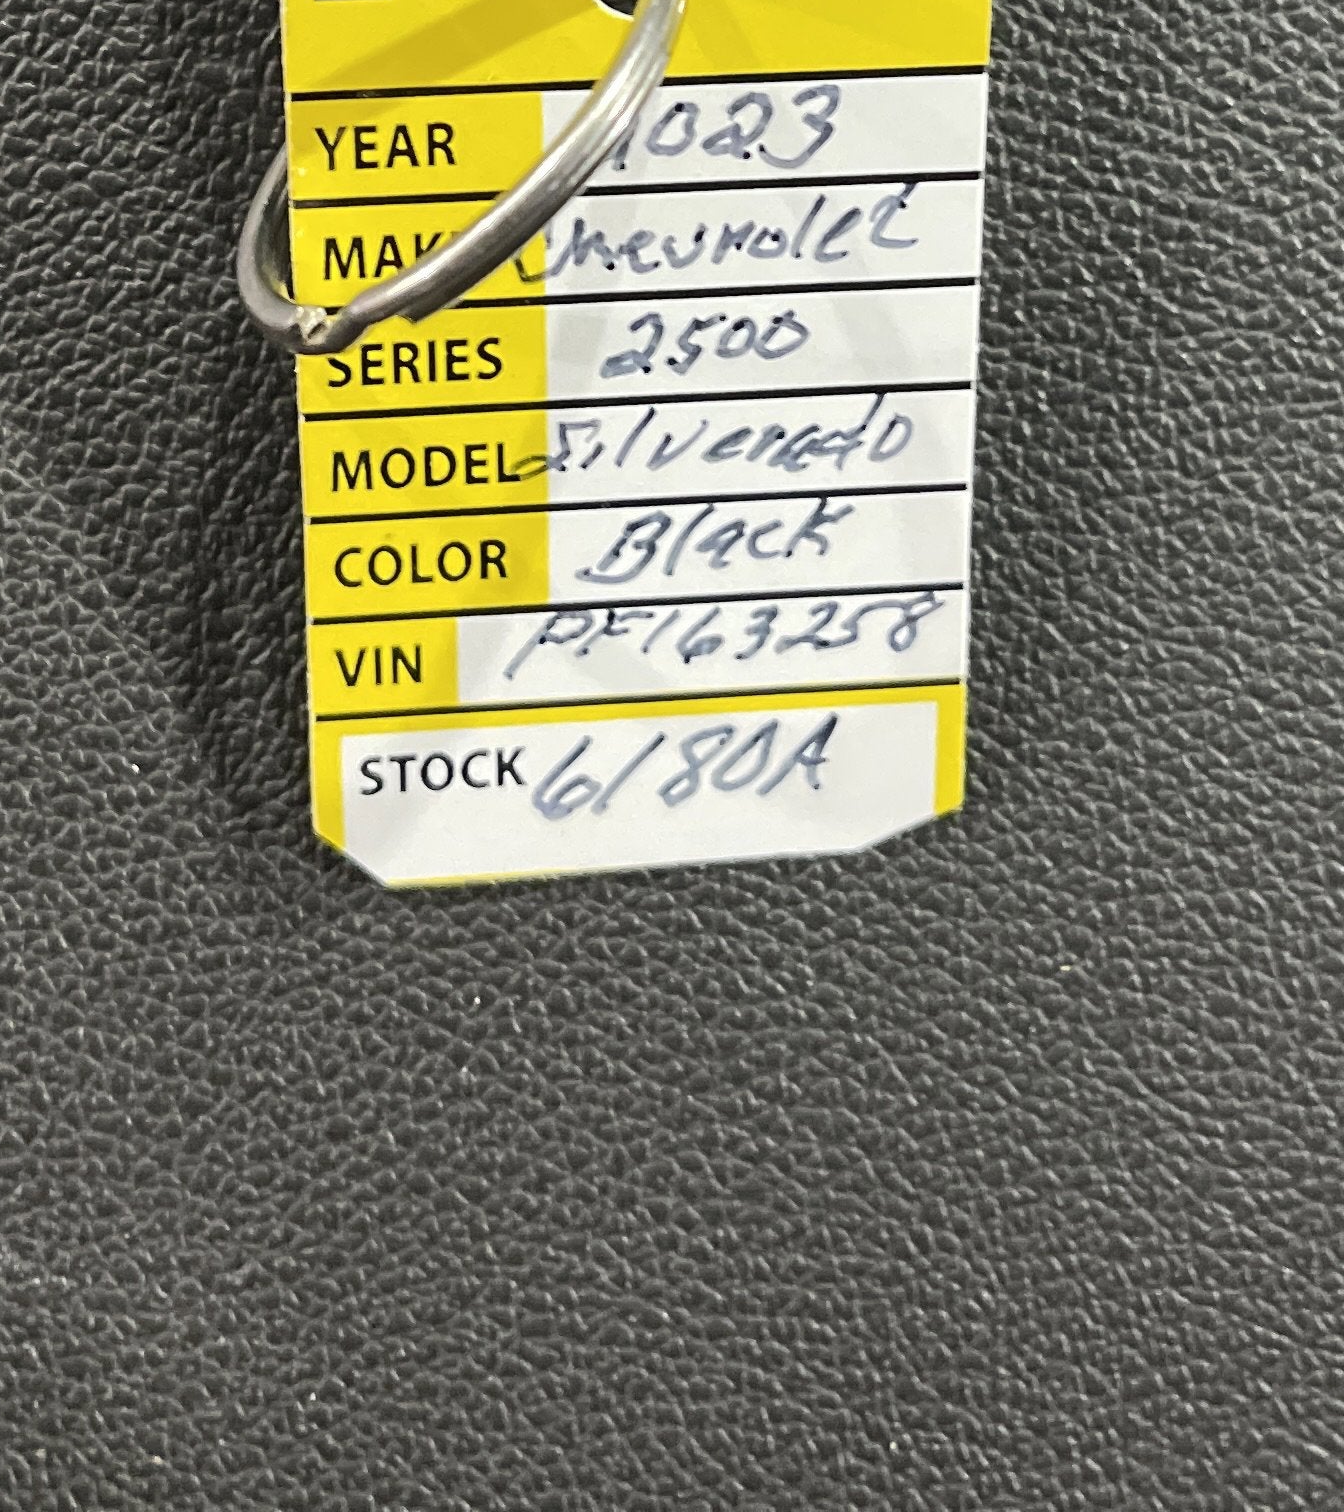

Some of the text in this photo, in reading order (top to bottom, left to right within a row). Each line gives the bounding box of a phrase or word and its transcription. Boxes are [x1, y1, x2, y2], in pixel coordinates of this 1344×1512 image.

[314, 121, 457, 171] YEAR
[323, 230, 463, 281] MAK
[327, 336, 504, 388] SERIES
[600, 309, 811, 382] 2500
[331, 443, 522, 492] MODEL
[334, 538, 508, 588] COLOR
[575, 496, 855, 585] Black
[336, 644, 424, 688] VIN
[360, 746, 528, 795] STOCK
[532, 711, 839, 821] 6180A
